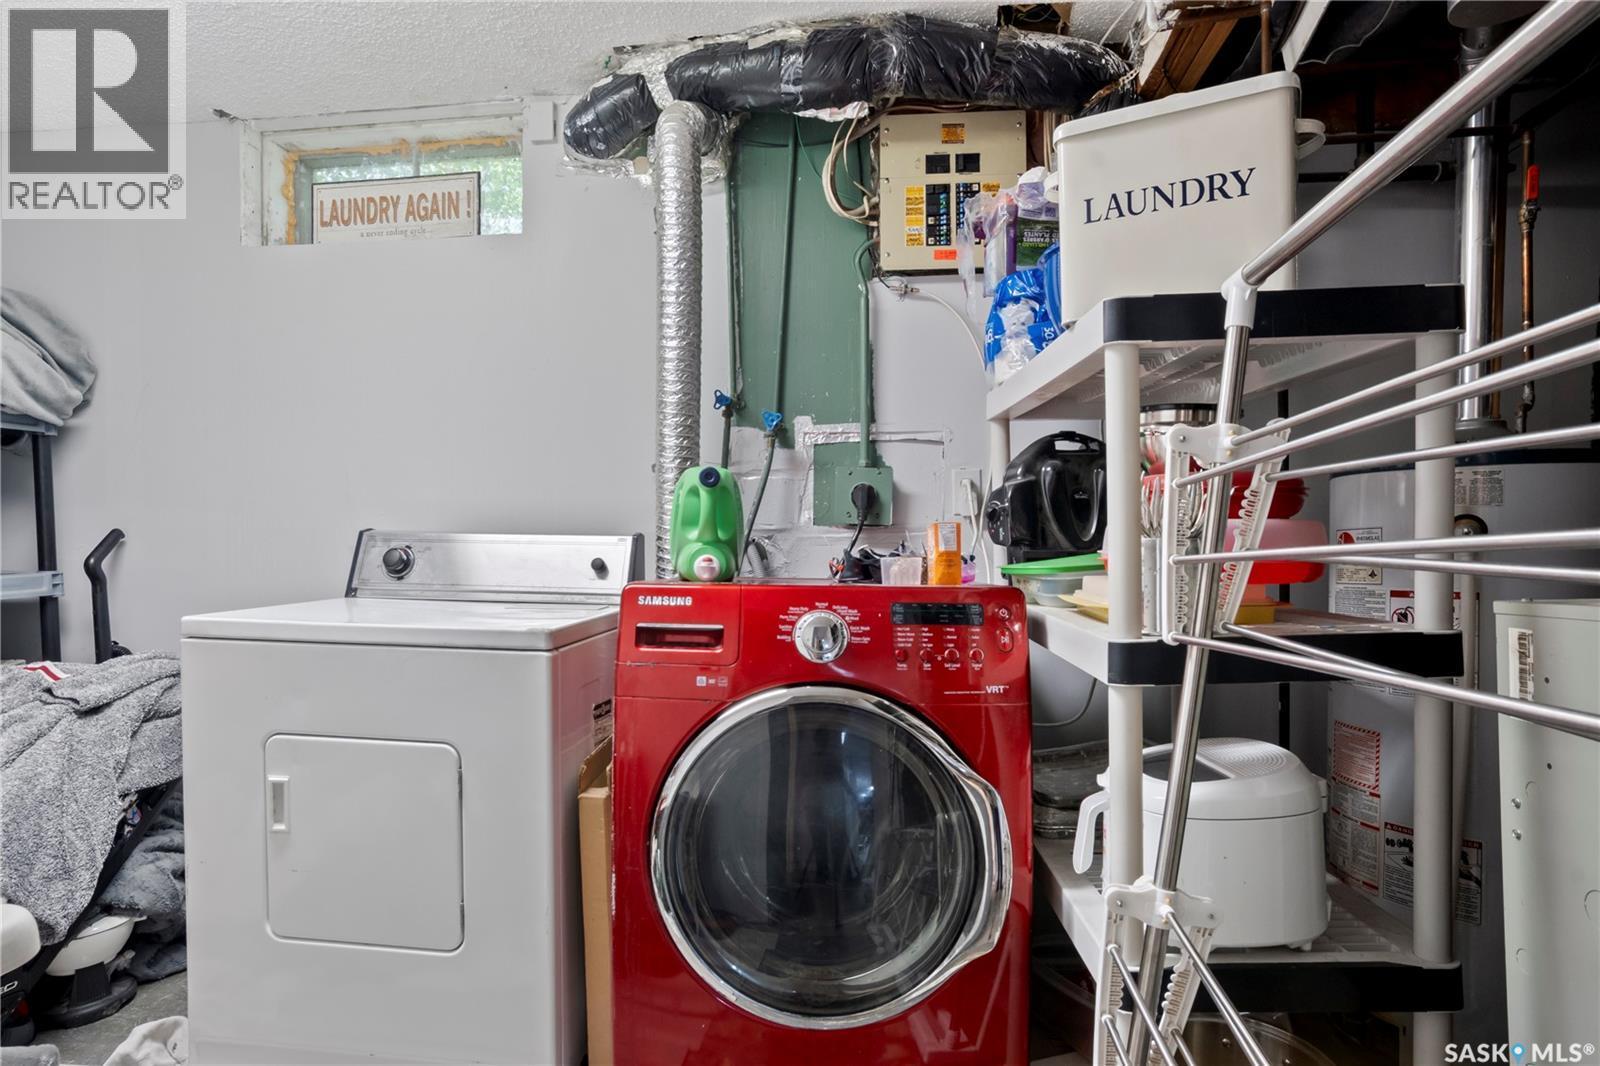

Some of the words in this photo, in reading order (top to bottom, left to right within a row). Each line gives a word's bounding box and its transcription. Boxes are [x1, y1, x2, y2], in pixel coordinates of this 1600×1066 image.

[1083, 167, 1257, 225] LAUNDRY
[319, 194, 401, 228] LAUNDRY
[405, 192, 460, 222] AGAIN
[466, 190, 472, 219] !
[386, 227, 408, 238] ending
[638, 595, 692, 606] SAMSUNG
